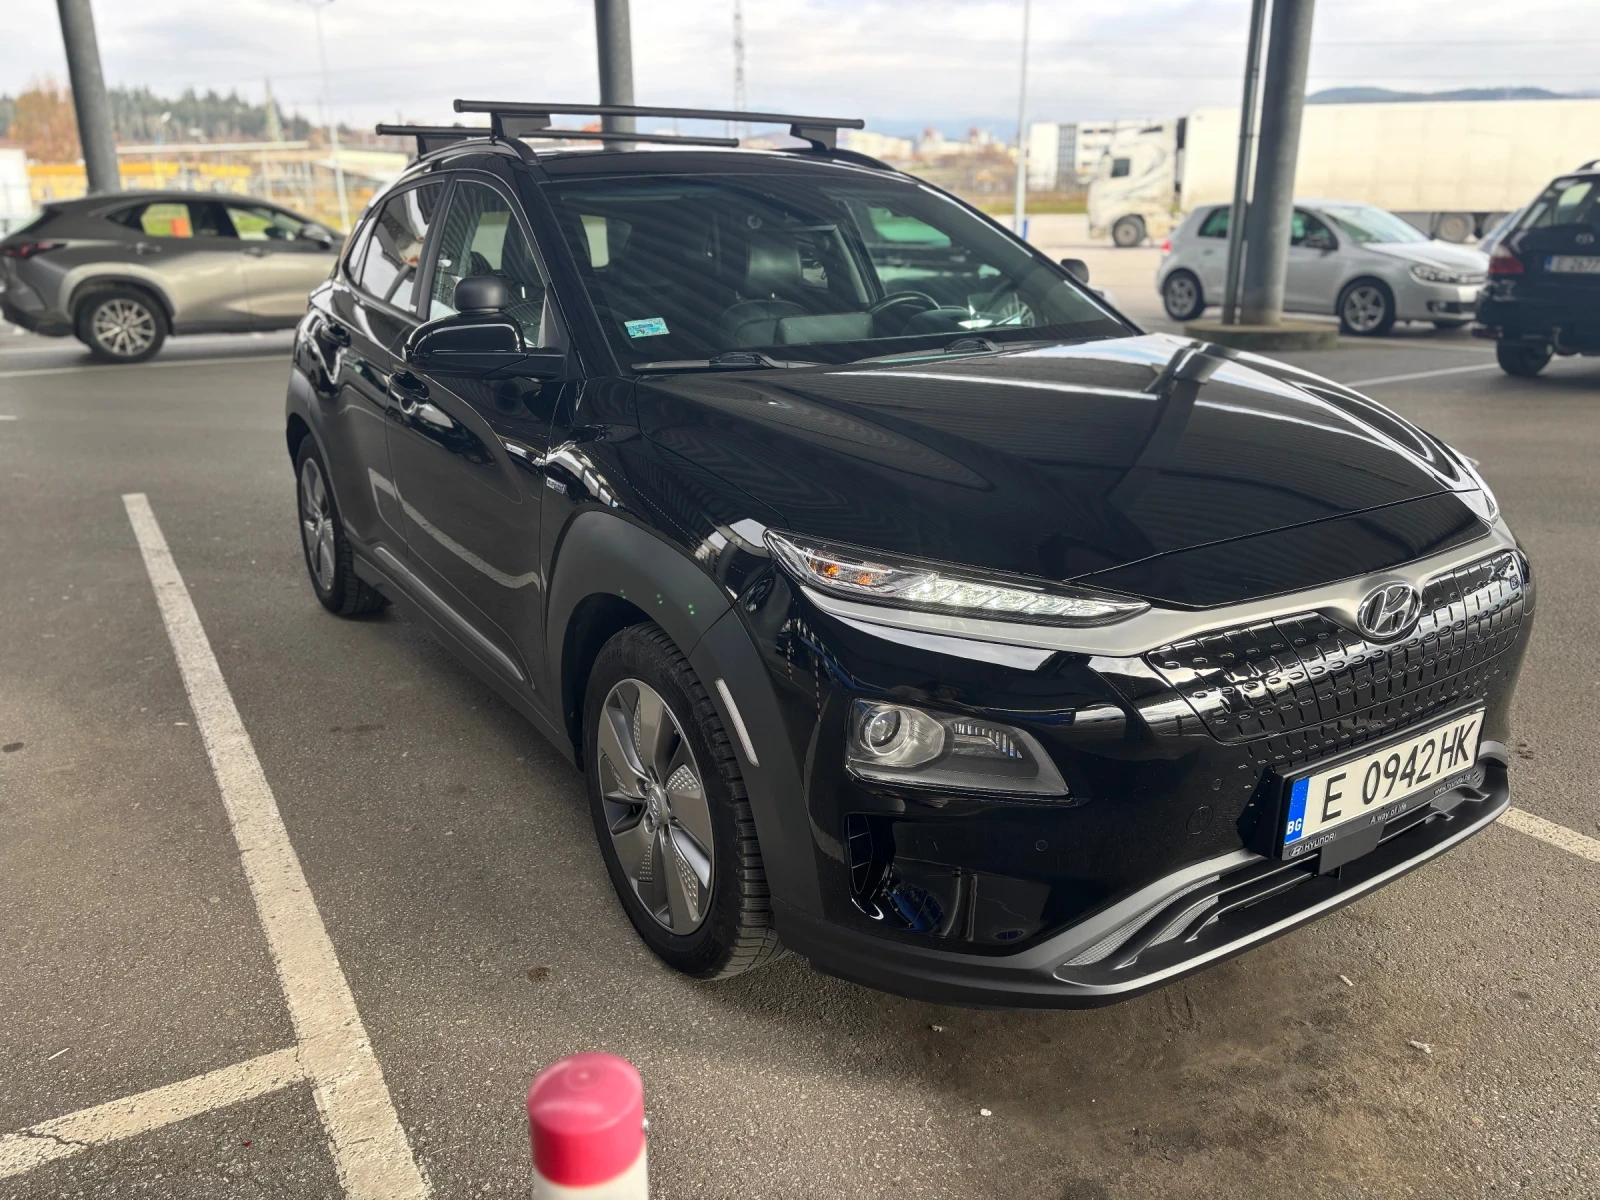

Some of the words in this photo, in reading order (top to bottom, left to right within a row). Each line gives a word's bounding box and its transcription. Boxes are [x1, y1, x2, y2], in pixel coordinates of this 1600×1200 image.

[1321, 772, 1347, 823] E
[1377, 811, 1390, 822] way
[1390, 807, 1398, 816] of
[1286, 818, 1303, 835] BG
[1304, 832, 1337, 851] HYUNDAI
